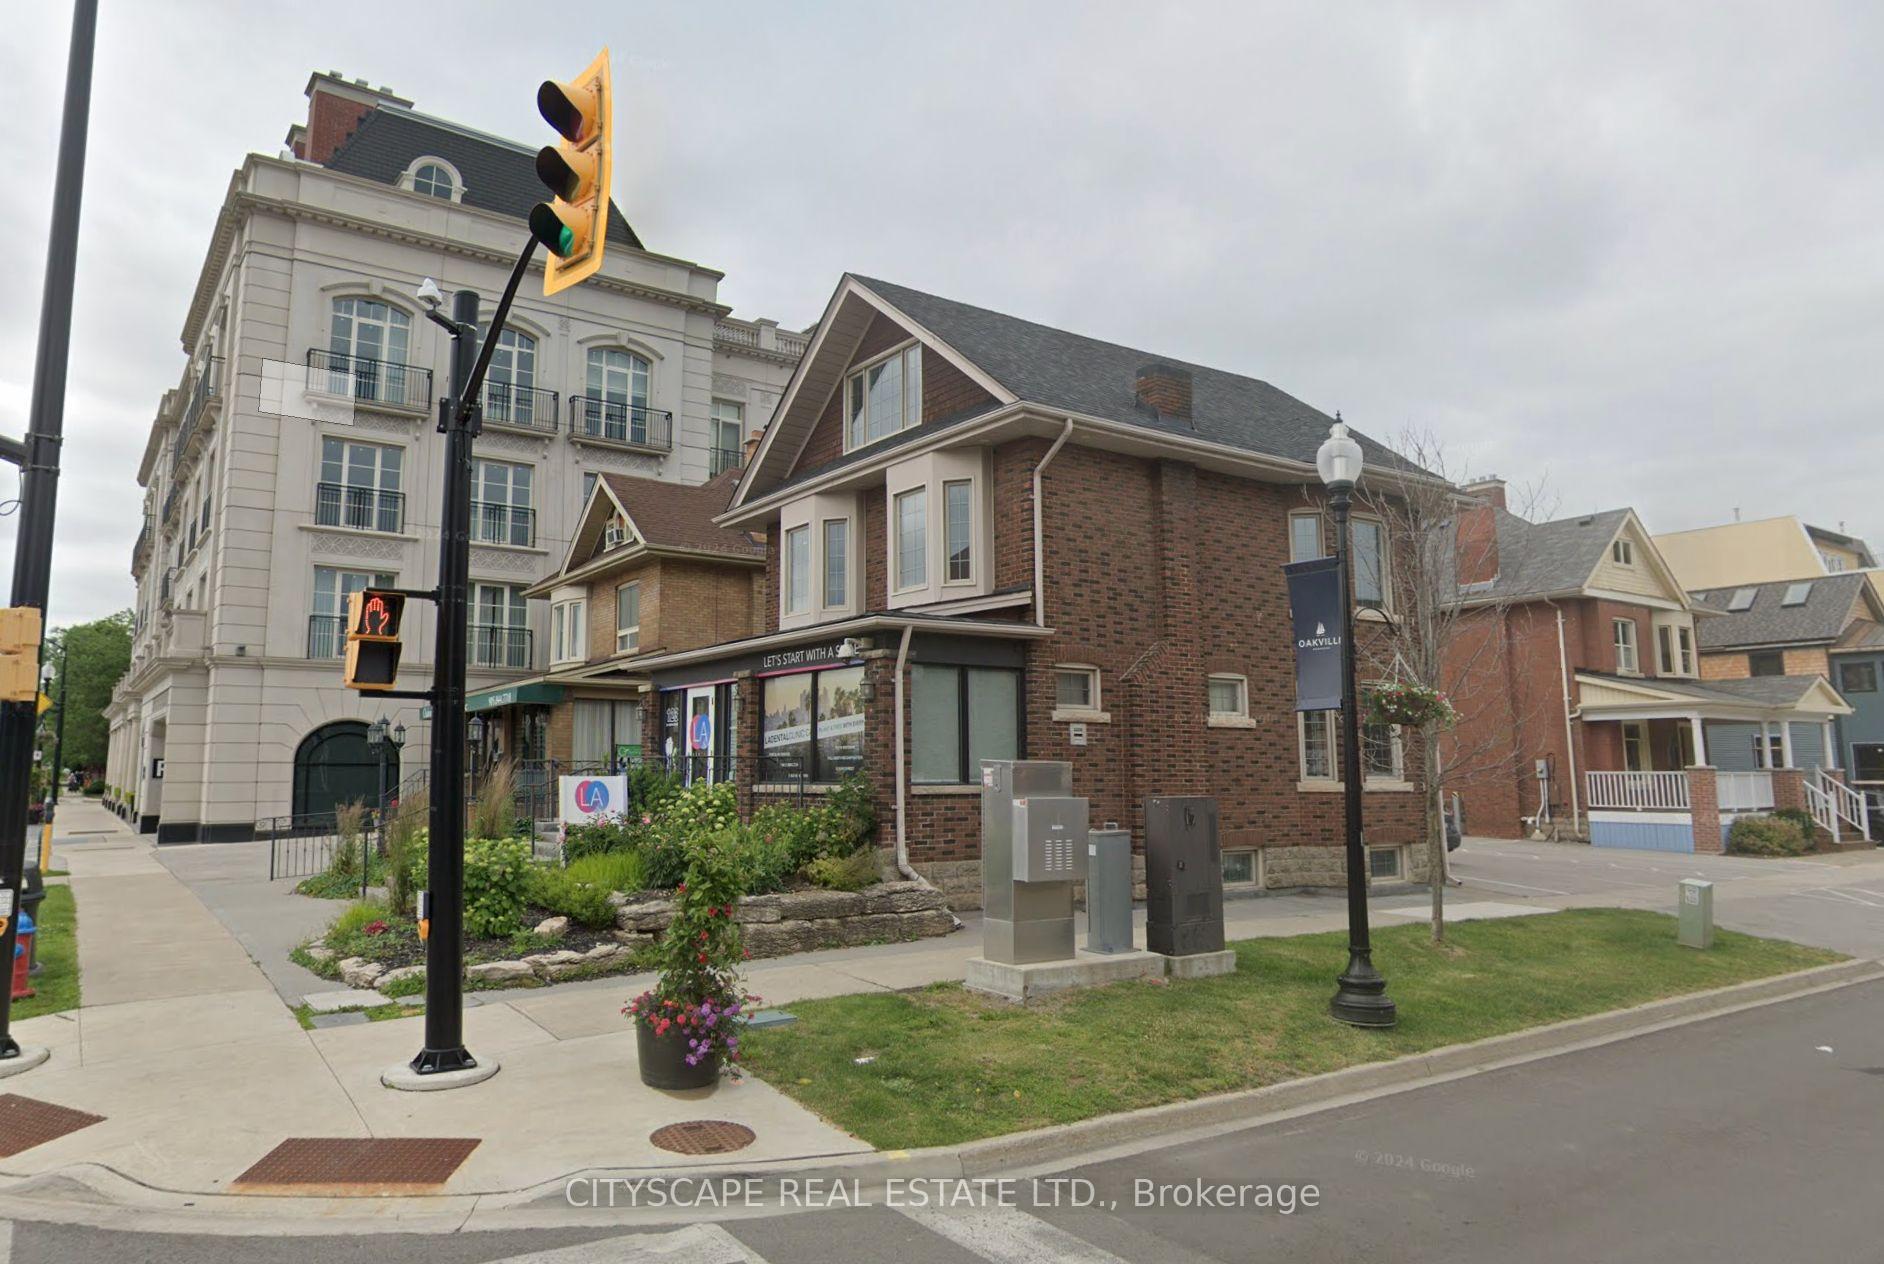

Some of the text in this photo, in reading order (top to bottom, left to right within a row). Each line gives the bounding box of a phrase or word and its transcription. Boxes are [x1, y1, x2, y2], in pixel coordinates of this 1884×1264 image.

[763, 654, 782, 668] LET'S
[782, 650, 805, 665] START
[805, 647, 826, 662] WITH
[827, 646, 834, 659] A
[692, 720, 708, 743] LA
[579, 787, 604, 807] LA
